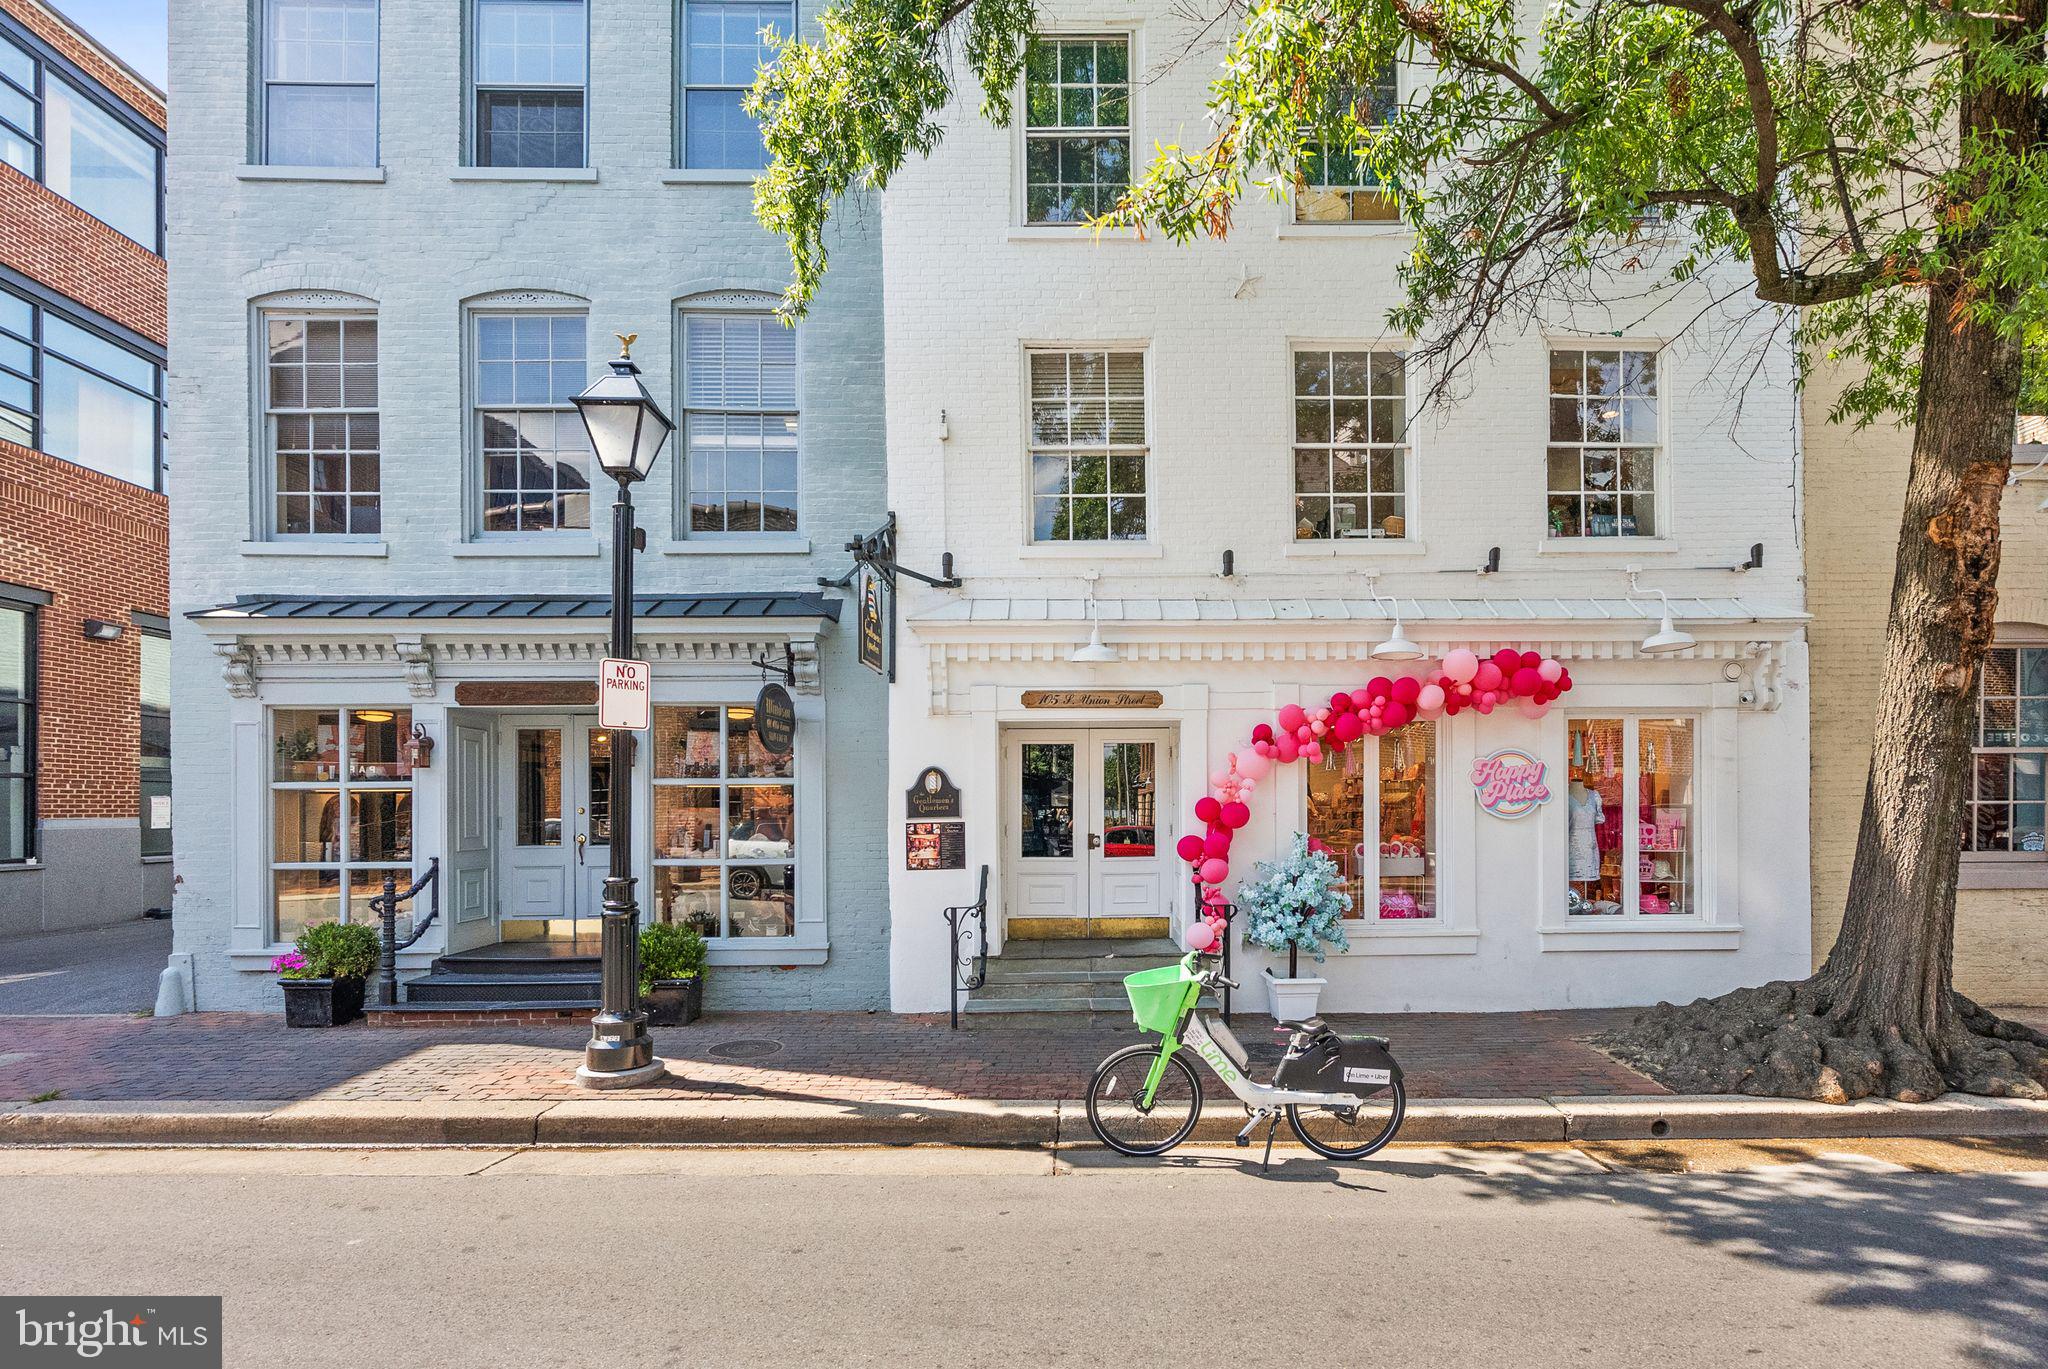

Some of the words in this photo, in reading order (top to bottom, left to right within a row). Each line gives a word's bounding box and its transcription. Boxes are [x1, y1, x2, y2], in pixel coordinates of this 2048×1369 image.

[616, 666, 636, 679] NO
[607, 678, 645, 691] PARKING
[1038, 693, 1062, 705] 105
[1079, 693, 1110, 705] Union
[1115, 693, 1146, 705] Street
[1471, 759, 1545, 787] Happy
[1480, 780, 1550, 808] Place
[1200, 1040, 1237, 1083] Lime
